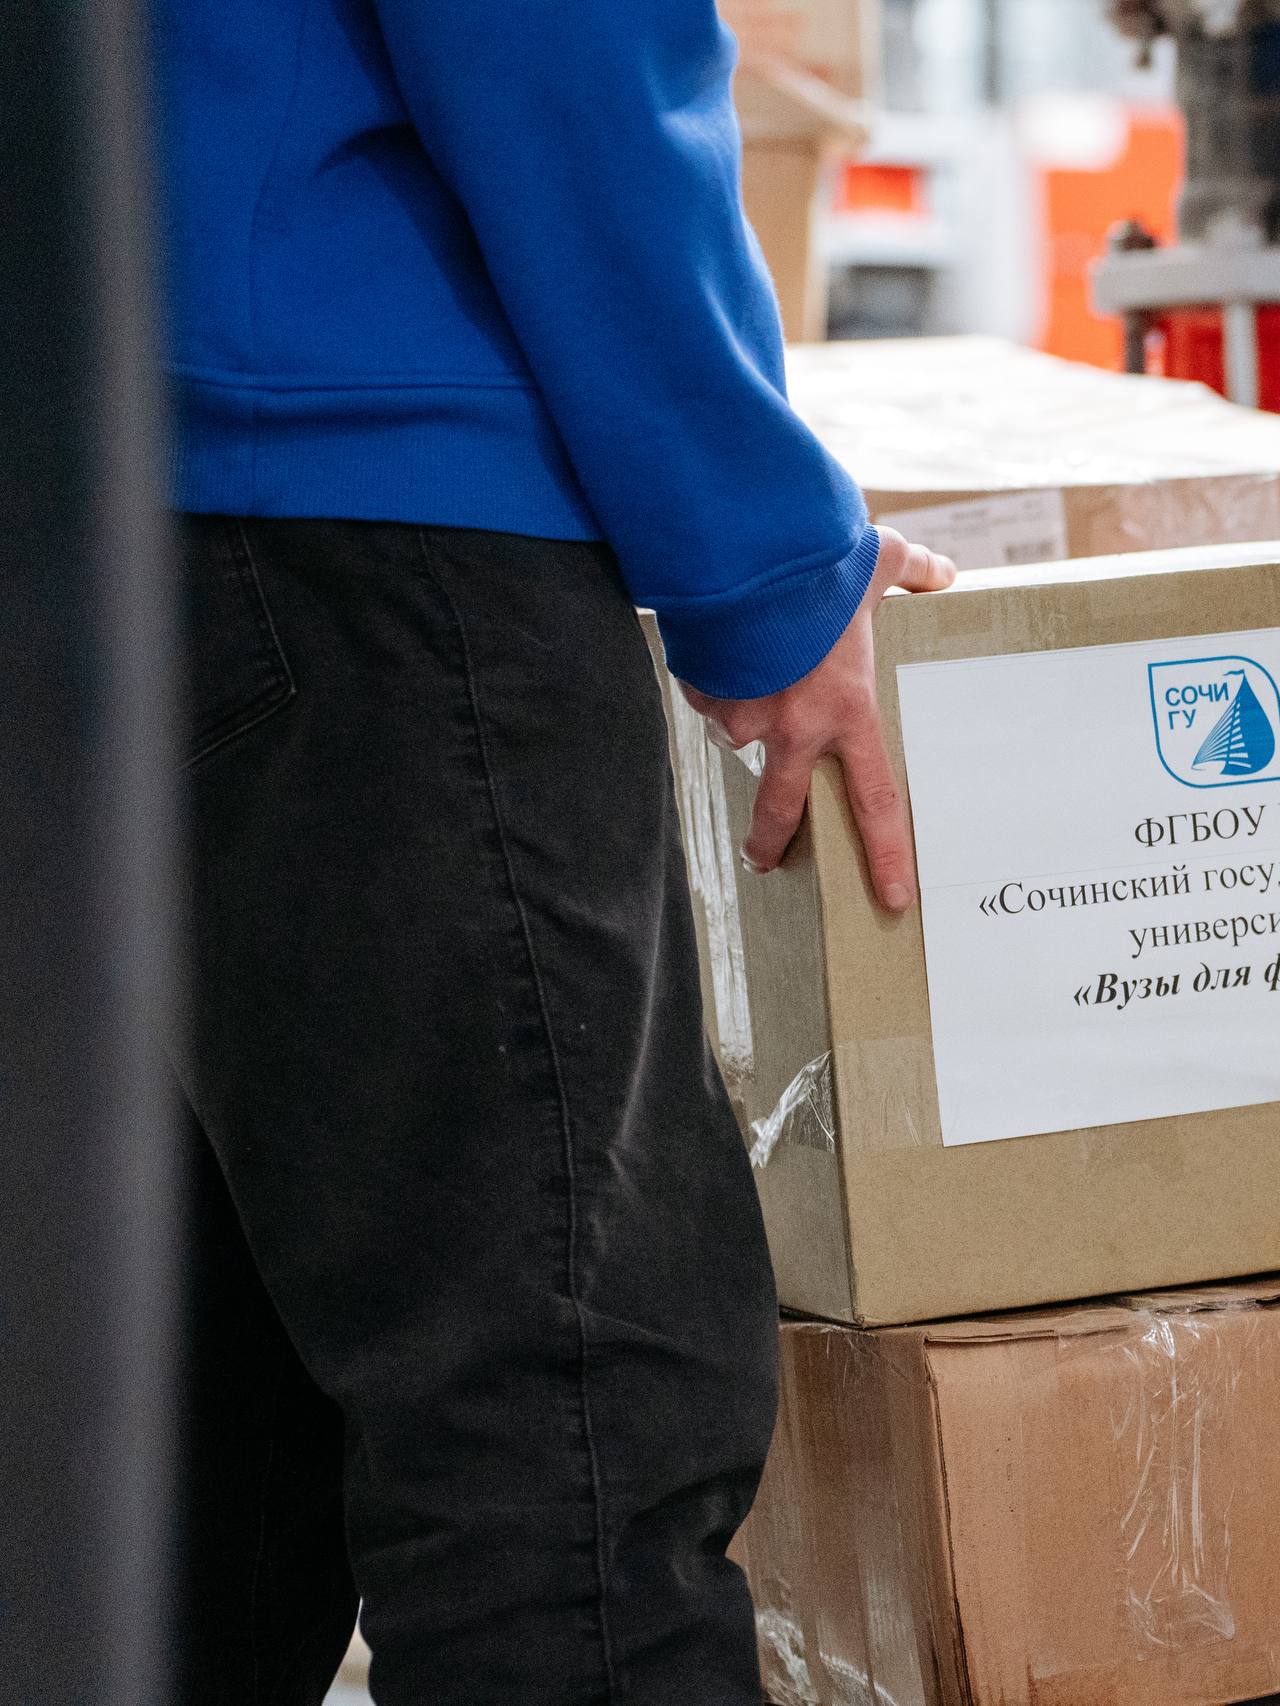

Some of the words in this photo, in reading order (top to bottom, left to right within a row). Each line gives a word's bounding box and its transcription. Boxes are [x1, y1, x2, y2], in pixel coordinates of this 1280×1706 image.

[1164, 682, 1230, 708] СОЧИ
[1167, 708, 1197, 731] ГУ
[1134, 804, 1266, 848] ФГБОУ
[978, 863, 1191, 917] «Сочинский
[1073, 972, 1181, 1011] «Вузы
[1192, 961, 1252, 993] для
